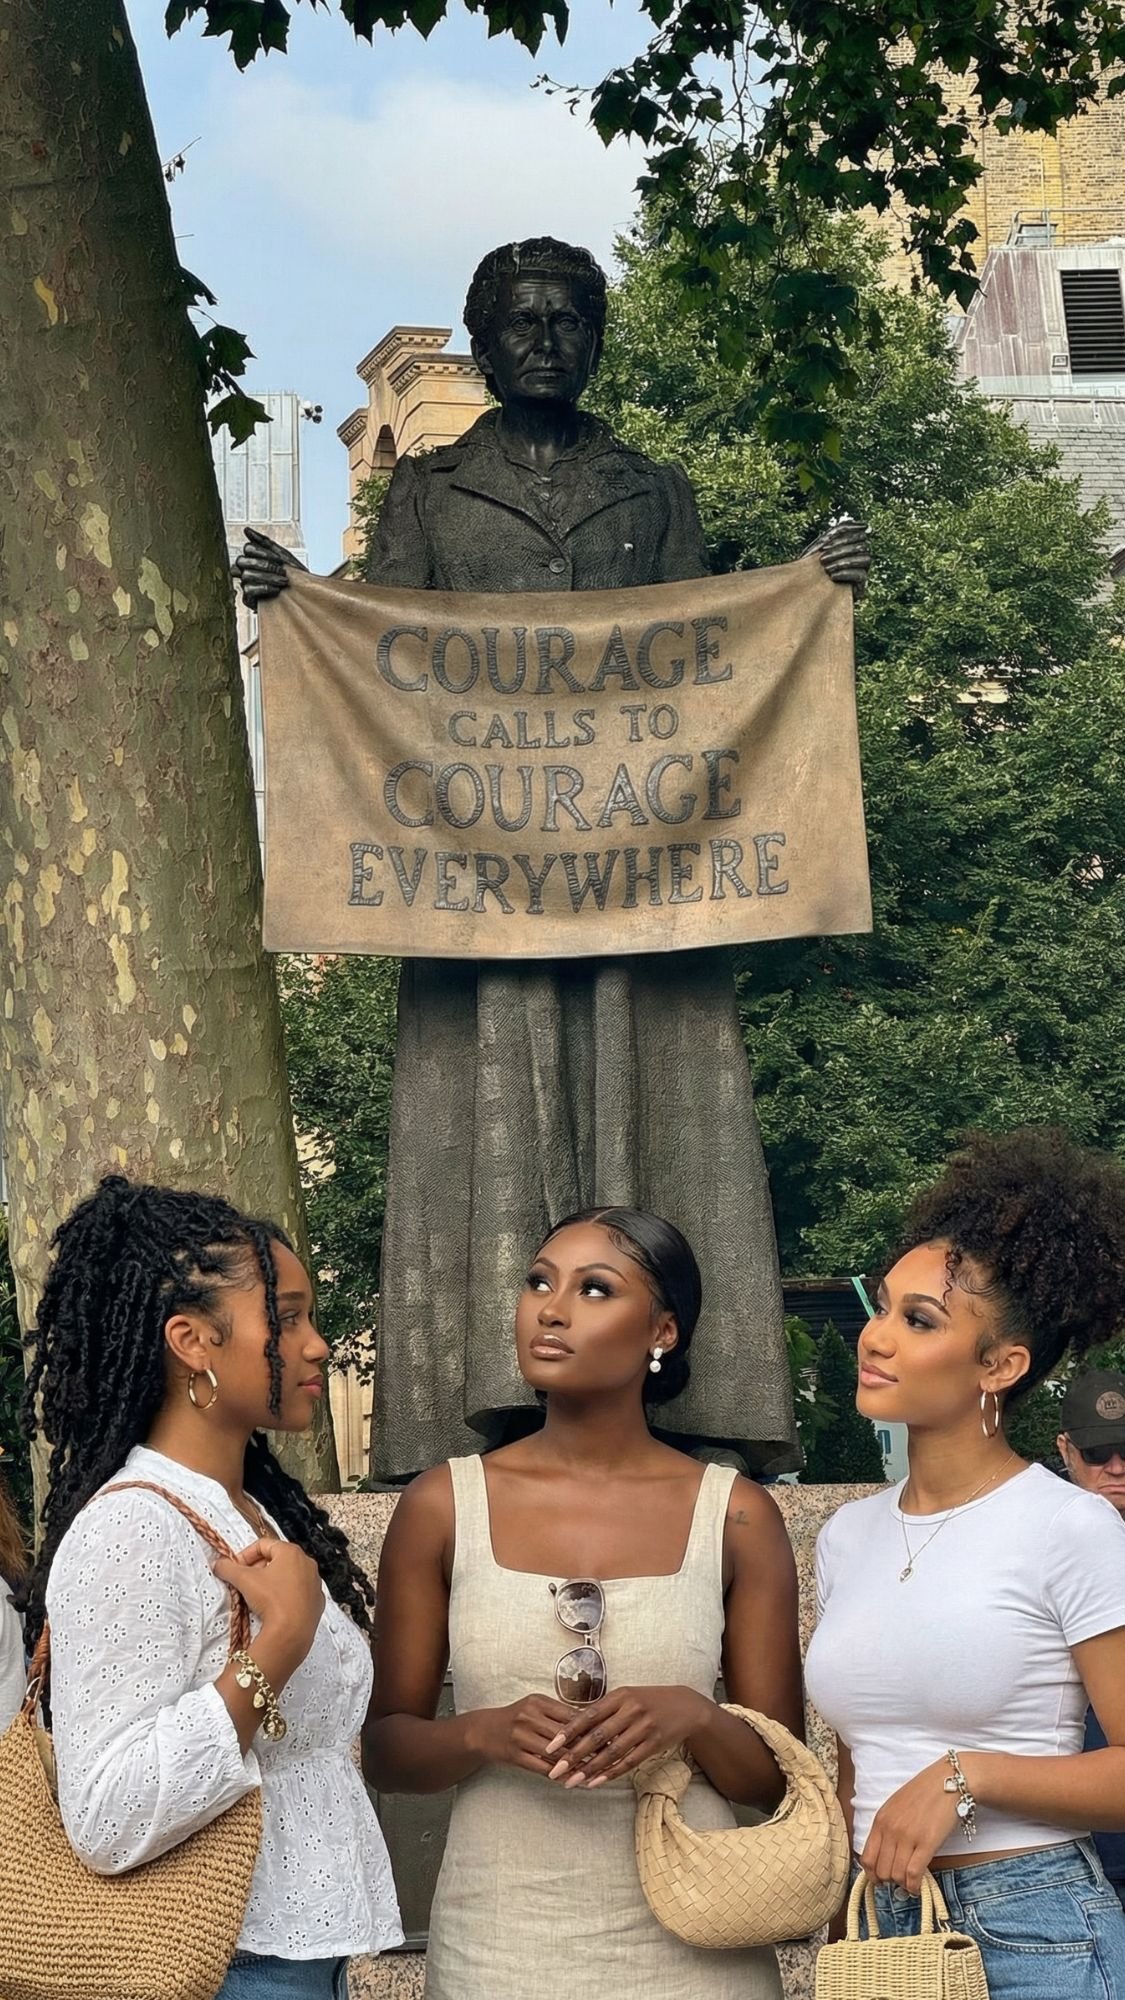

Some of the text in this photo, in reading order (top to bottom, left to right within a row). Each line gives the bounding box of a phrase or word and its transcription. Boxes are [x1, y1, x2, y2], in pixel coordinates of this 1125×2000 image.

[377, 615, 733, 694] COURAGE
[449, 704, 679, 749] CALLS TO
[384, 750, 742, 832] COURAGE
[348, 833, 790, 914] EVERYWHERE
